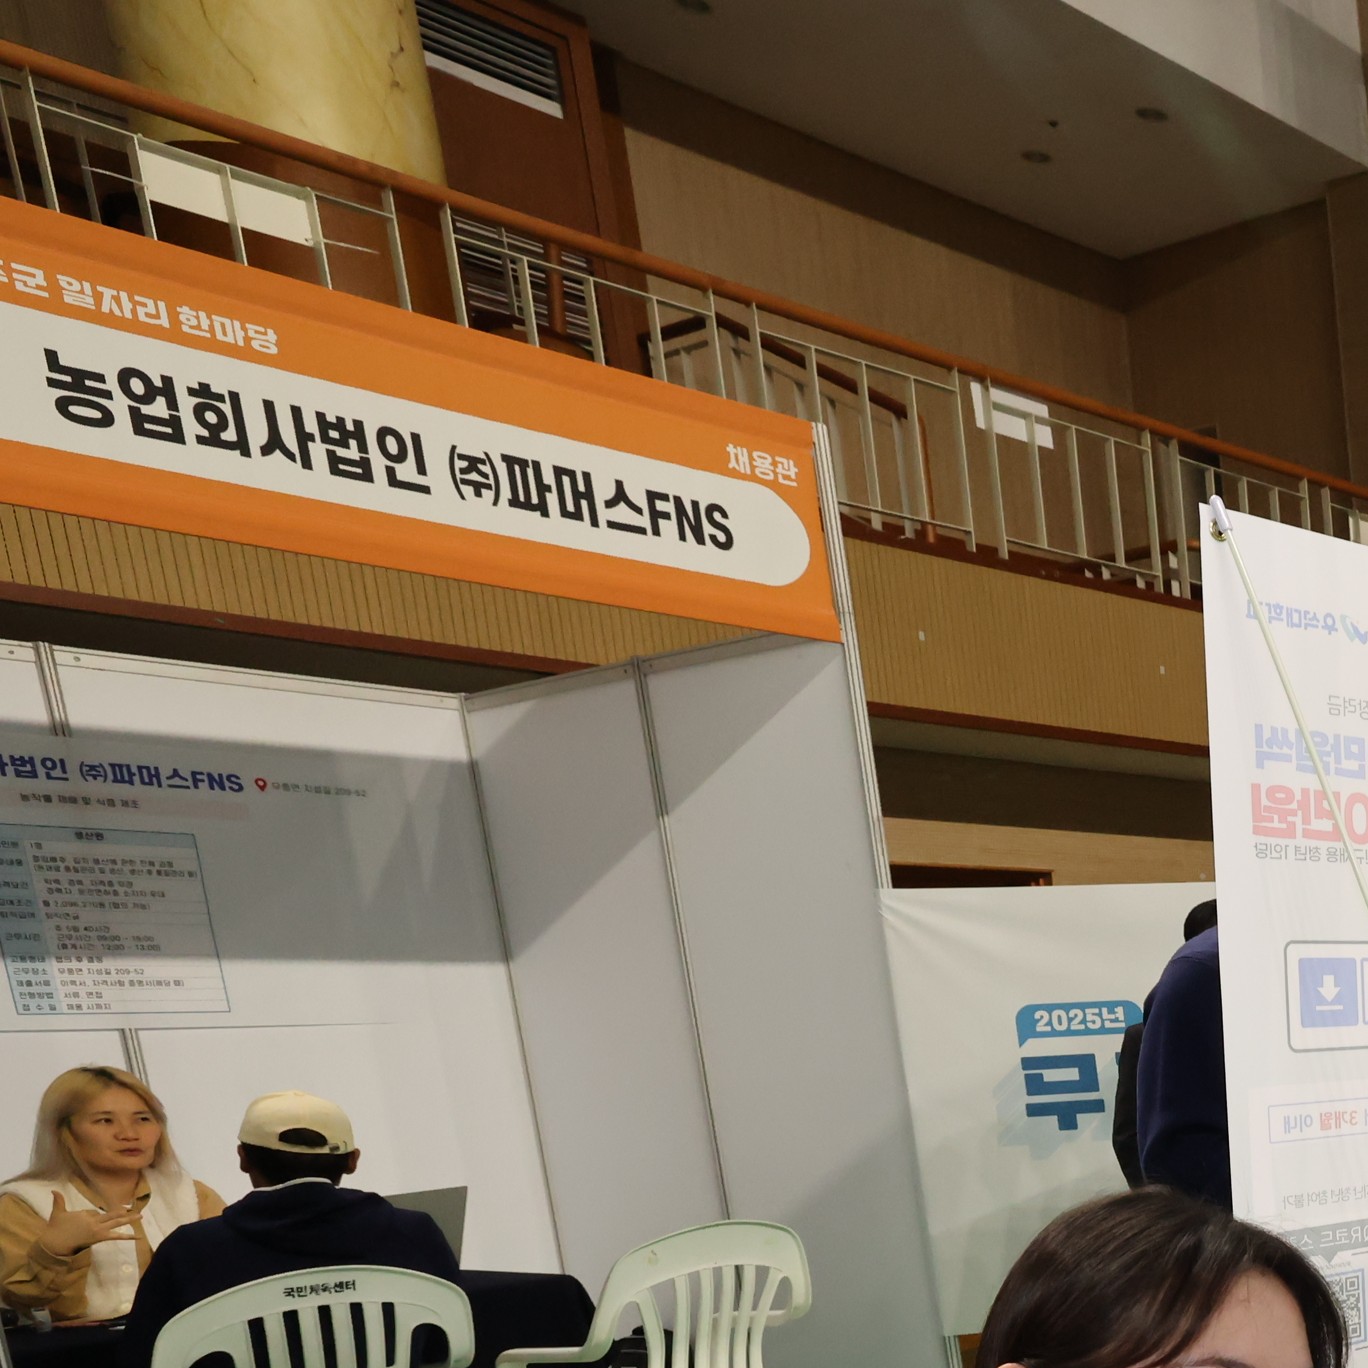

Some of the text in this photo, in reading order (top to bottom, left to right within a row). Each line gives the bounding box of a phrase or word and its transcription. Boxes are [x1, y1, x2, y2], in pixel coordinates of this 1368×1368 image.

[0, 258, 278, 354] 군 일자리 한마당
[43, 348, 431, 495] 농업회사법인
[724, 444, 800, 488] 채용관
[1034, 1006, 1126, 1032] 2025년
